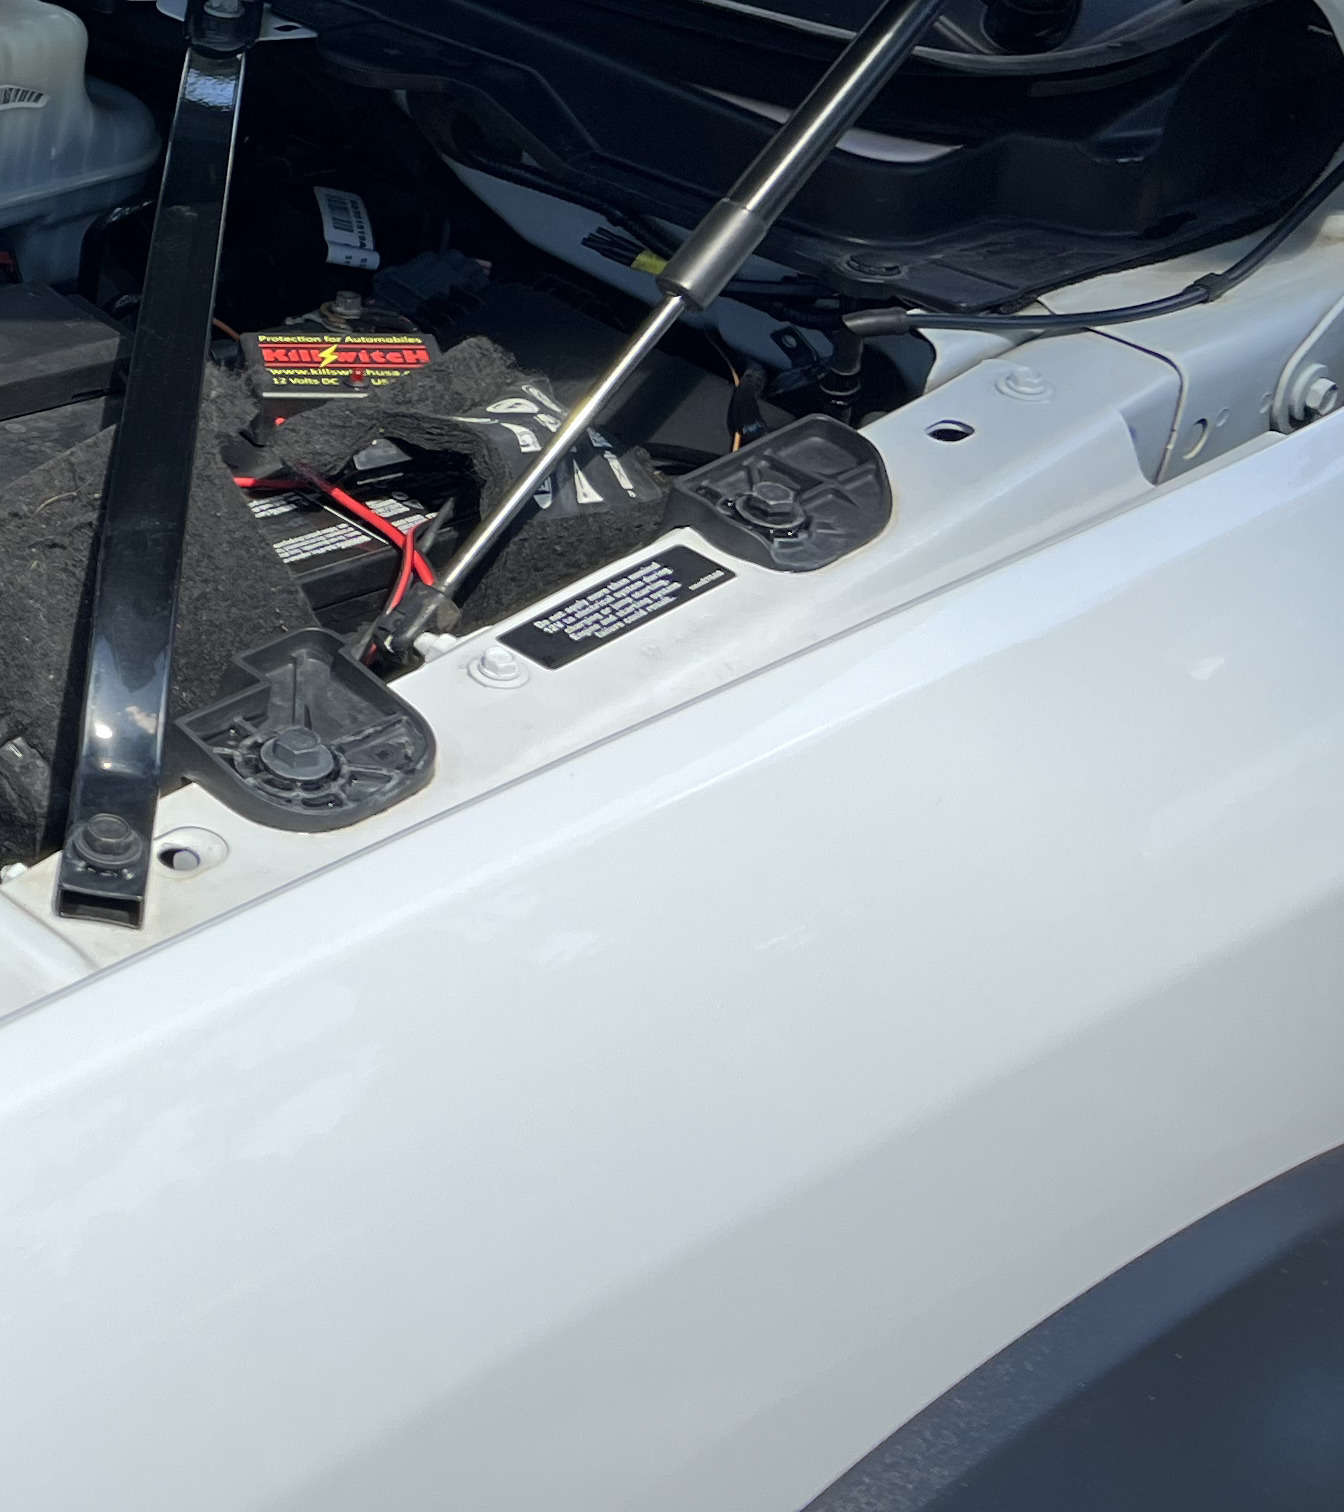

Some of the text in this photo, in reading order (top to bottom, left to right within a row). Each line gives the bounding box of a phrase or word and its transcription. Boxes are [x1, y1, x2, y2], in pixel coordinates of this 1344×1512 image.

[258, 335, 322, 343] Protection
[344, 335, 422, 344] Automobiles
[273, 377, 287, 385] 12
[289, 377, 320, 386] Volts
[321, 377, 340, 386] DC
